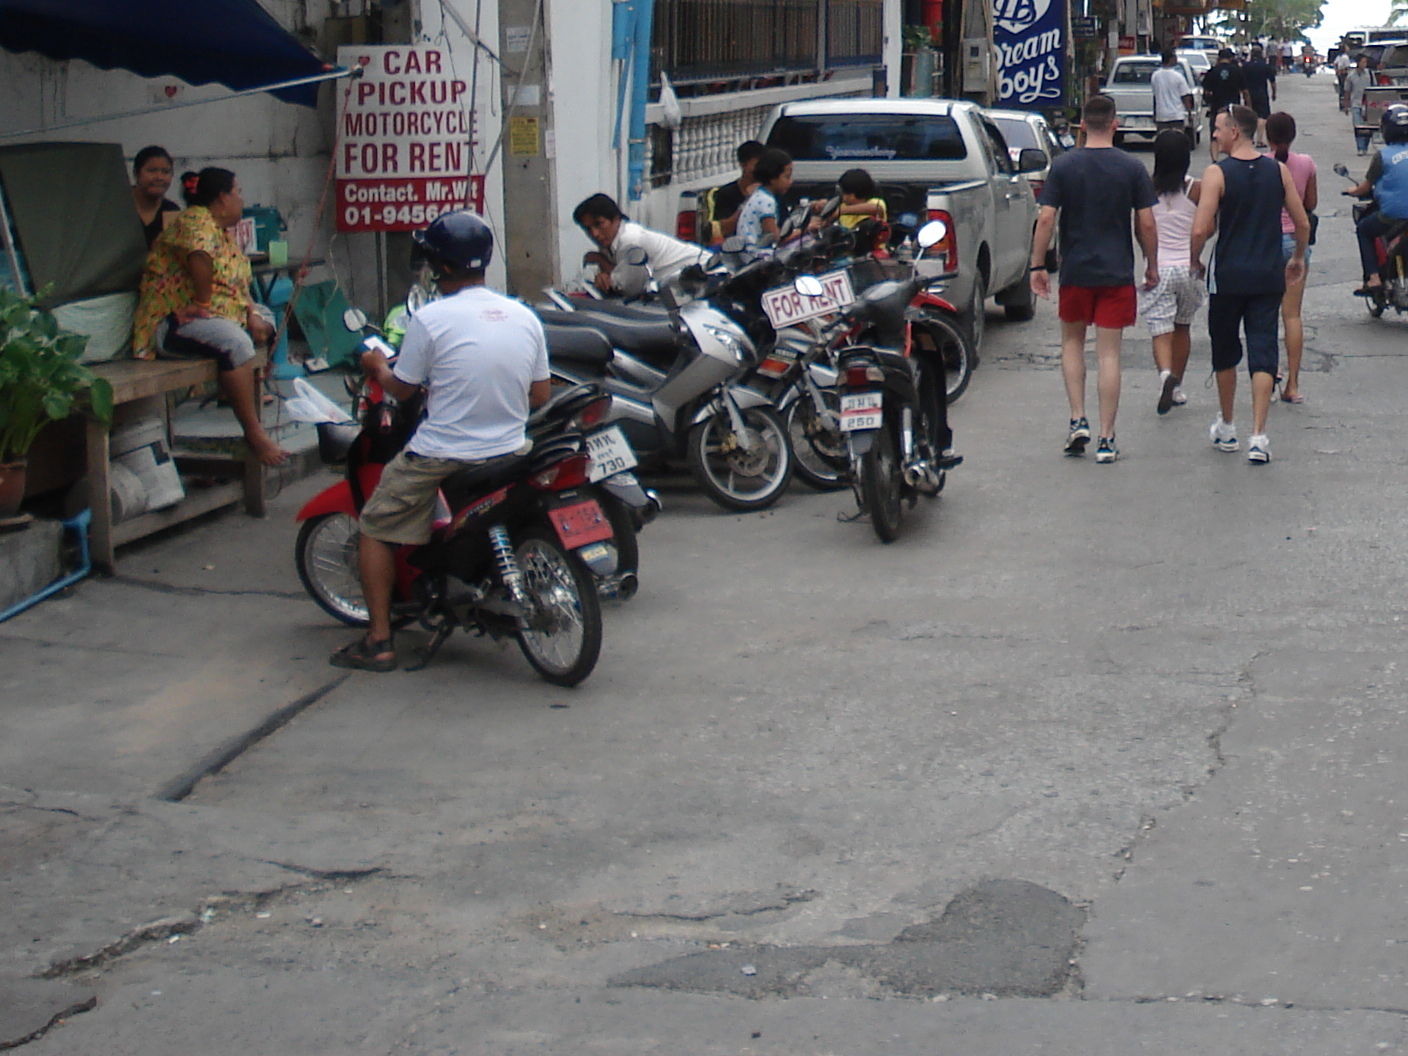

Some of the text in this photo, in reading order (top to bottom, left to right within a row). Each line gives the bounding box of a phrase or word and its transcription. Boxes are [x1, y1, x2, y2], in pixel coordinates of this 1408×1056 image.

[383, 50, 442, 76] CAR
[999, 55, 1061, 104] boys
[357, 80, 467, 106] PICKUP
[345, 110, 479, 137] MOTORCYCLE
[344, 141, 479, 174] FOR RENT
[345, 183, 419, 204] Contact.
[771, 278, 846, 322] FOR RENT
[847, 416, 875, 429] 250
[597, 456, 625, 476] 730
